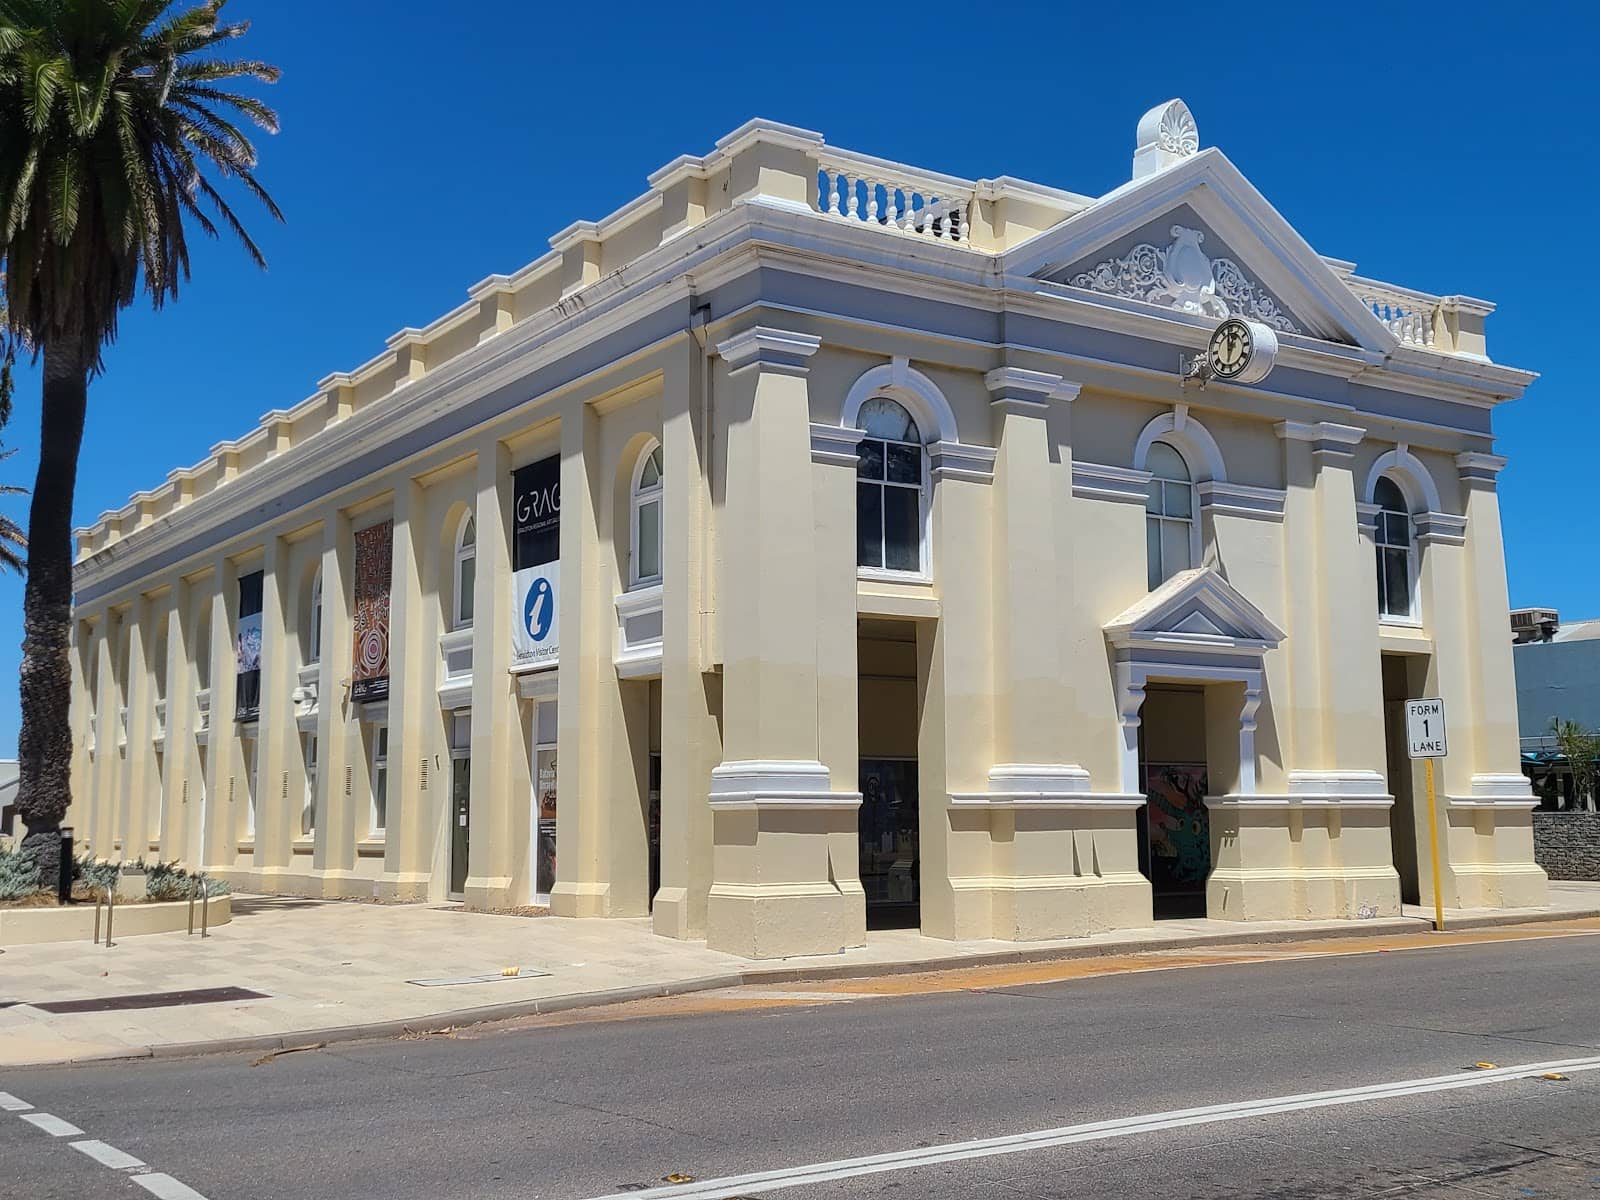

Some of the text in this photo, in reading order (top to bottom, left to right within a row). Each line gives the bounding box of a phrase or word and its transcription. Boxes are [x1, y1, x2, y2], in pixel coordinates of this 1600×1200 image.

[1411, 704, 1439, 716] FORM
[1423, 719, 1429, 738] 1
[1413, 741, 1442, 752] LANE
